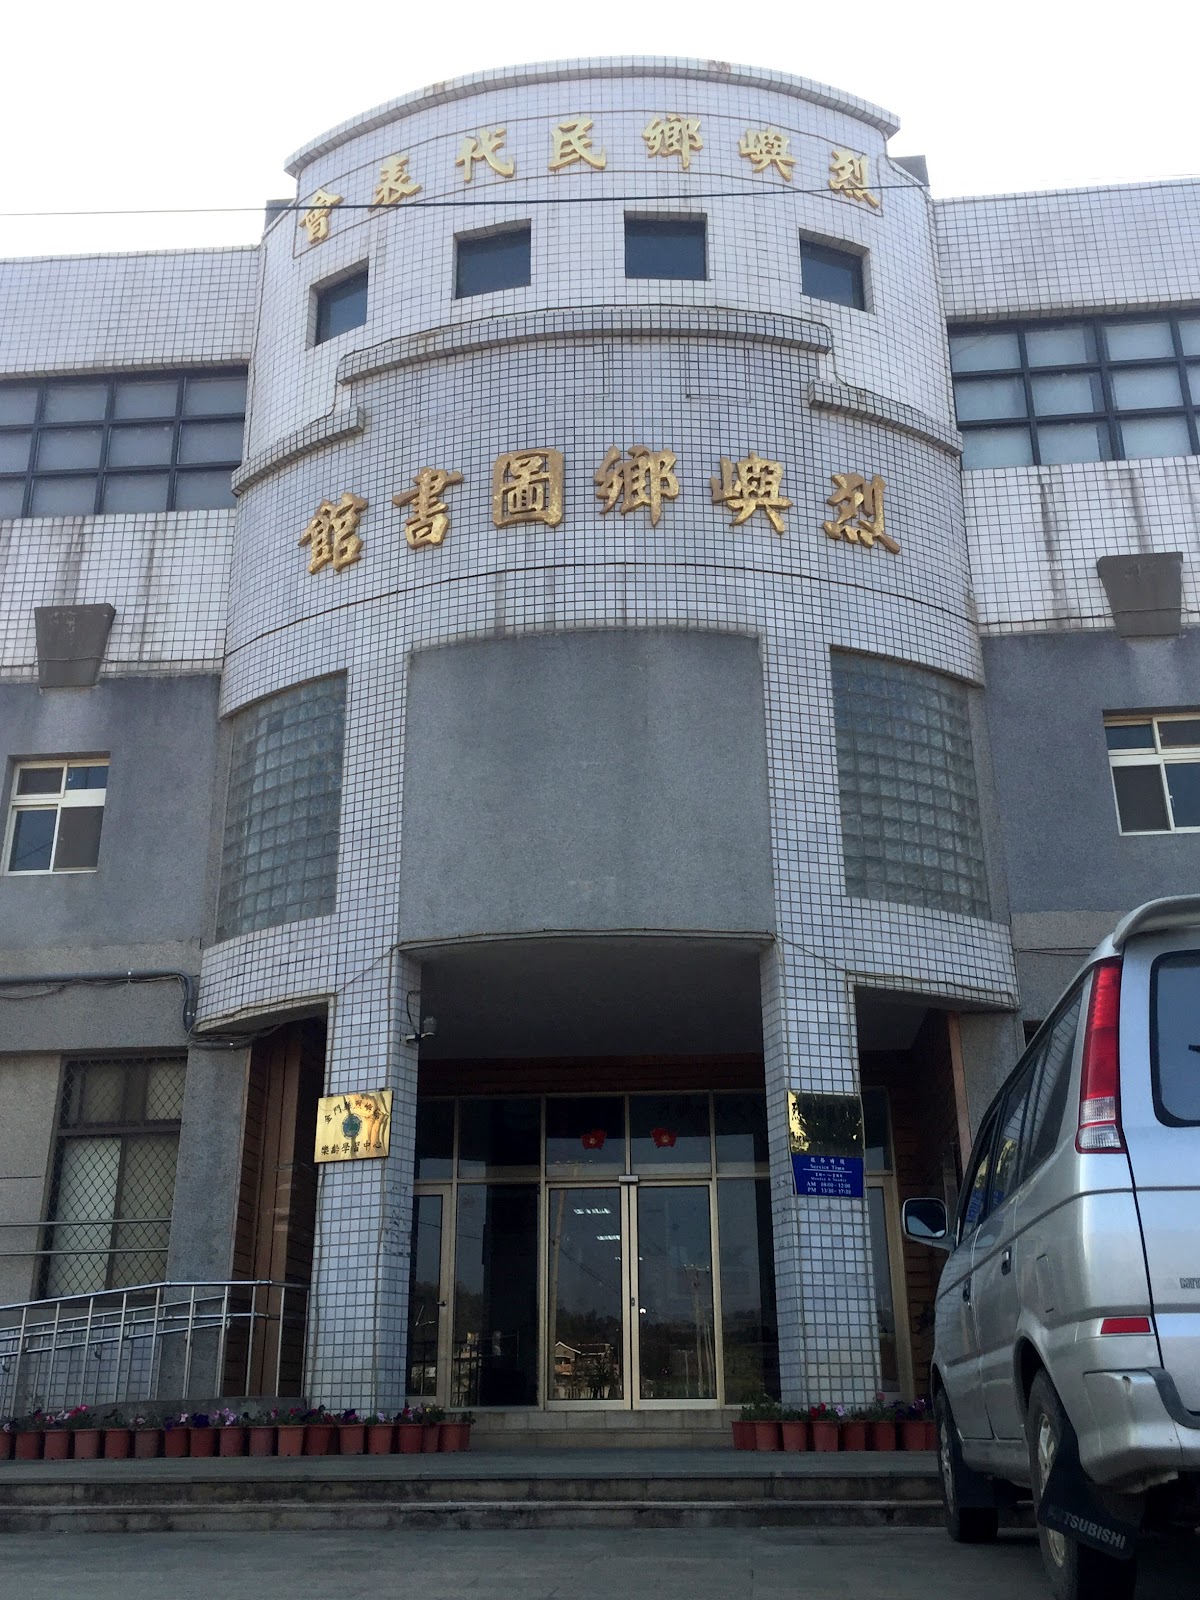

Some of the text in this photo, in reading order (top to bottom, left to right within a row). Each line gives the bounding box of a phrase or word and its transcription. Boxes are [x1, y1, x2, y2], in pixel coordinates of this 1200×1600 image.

[298, 113, 879, 244] 烈嶼鄉民代表會
[299, 444, 901, 575] 烈嶼鄉圖書館
[1047, 1504, 1126, 1550] MTSUBISHI
